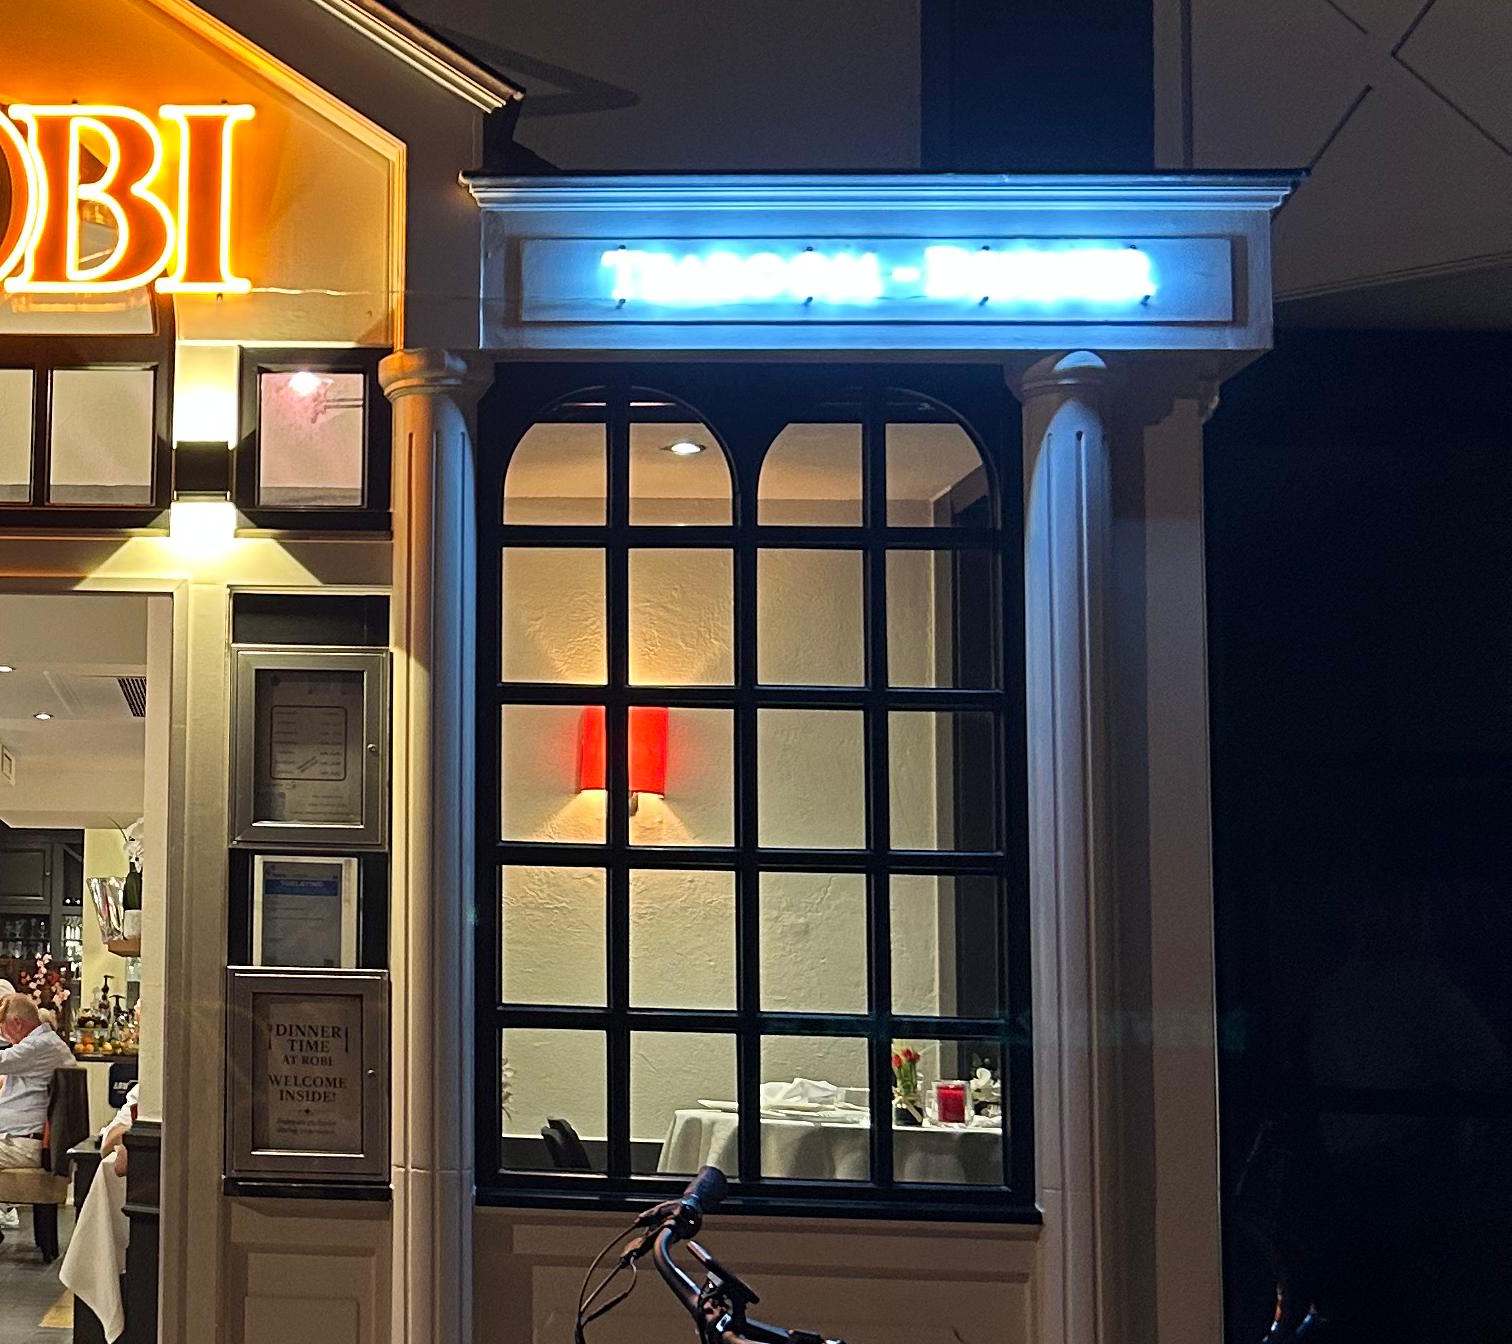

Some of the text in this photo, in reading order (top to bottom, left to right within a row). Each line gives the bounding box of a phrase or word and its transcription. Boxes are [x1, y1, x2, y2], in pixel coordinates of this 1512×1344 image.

[276, 1022, 342, 1039] DINNER
[287, 1038, 330, 1053] TIME
[282, 1055, 333, 1067] AT ROBI
[267, 1074, 348, 1089] WELCOME
[279, 1089, 337, 1103] INSIDE!
